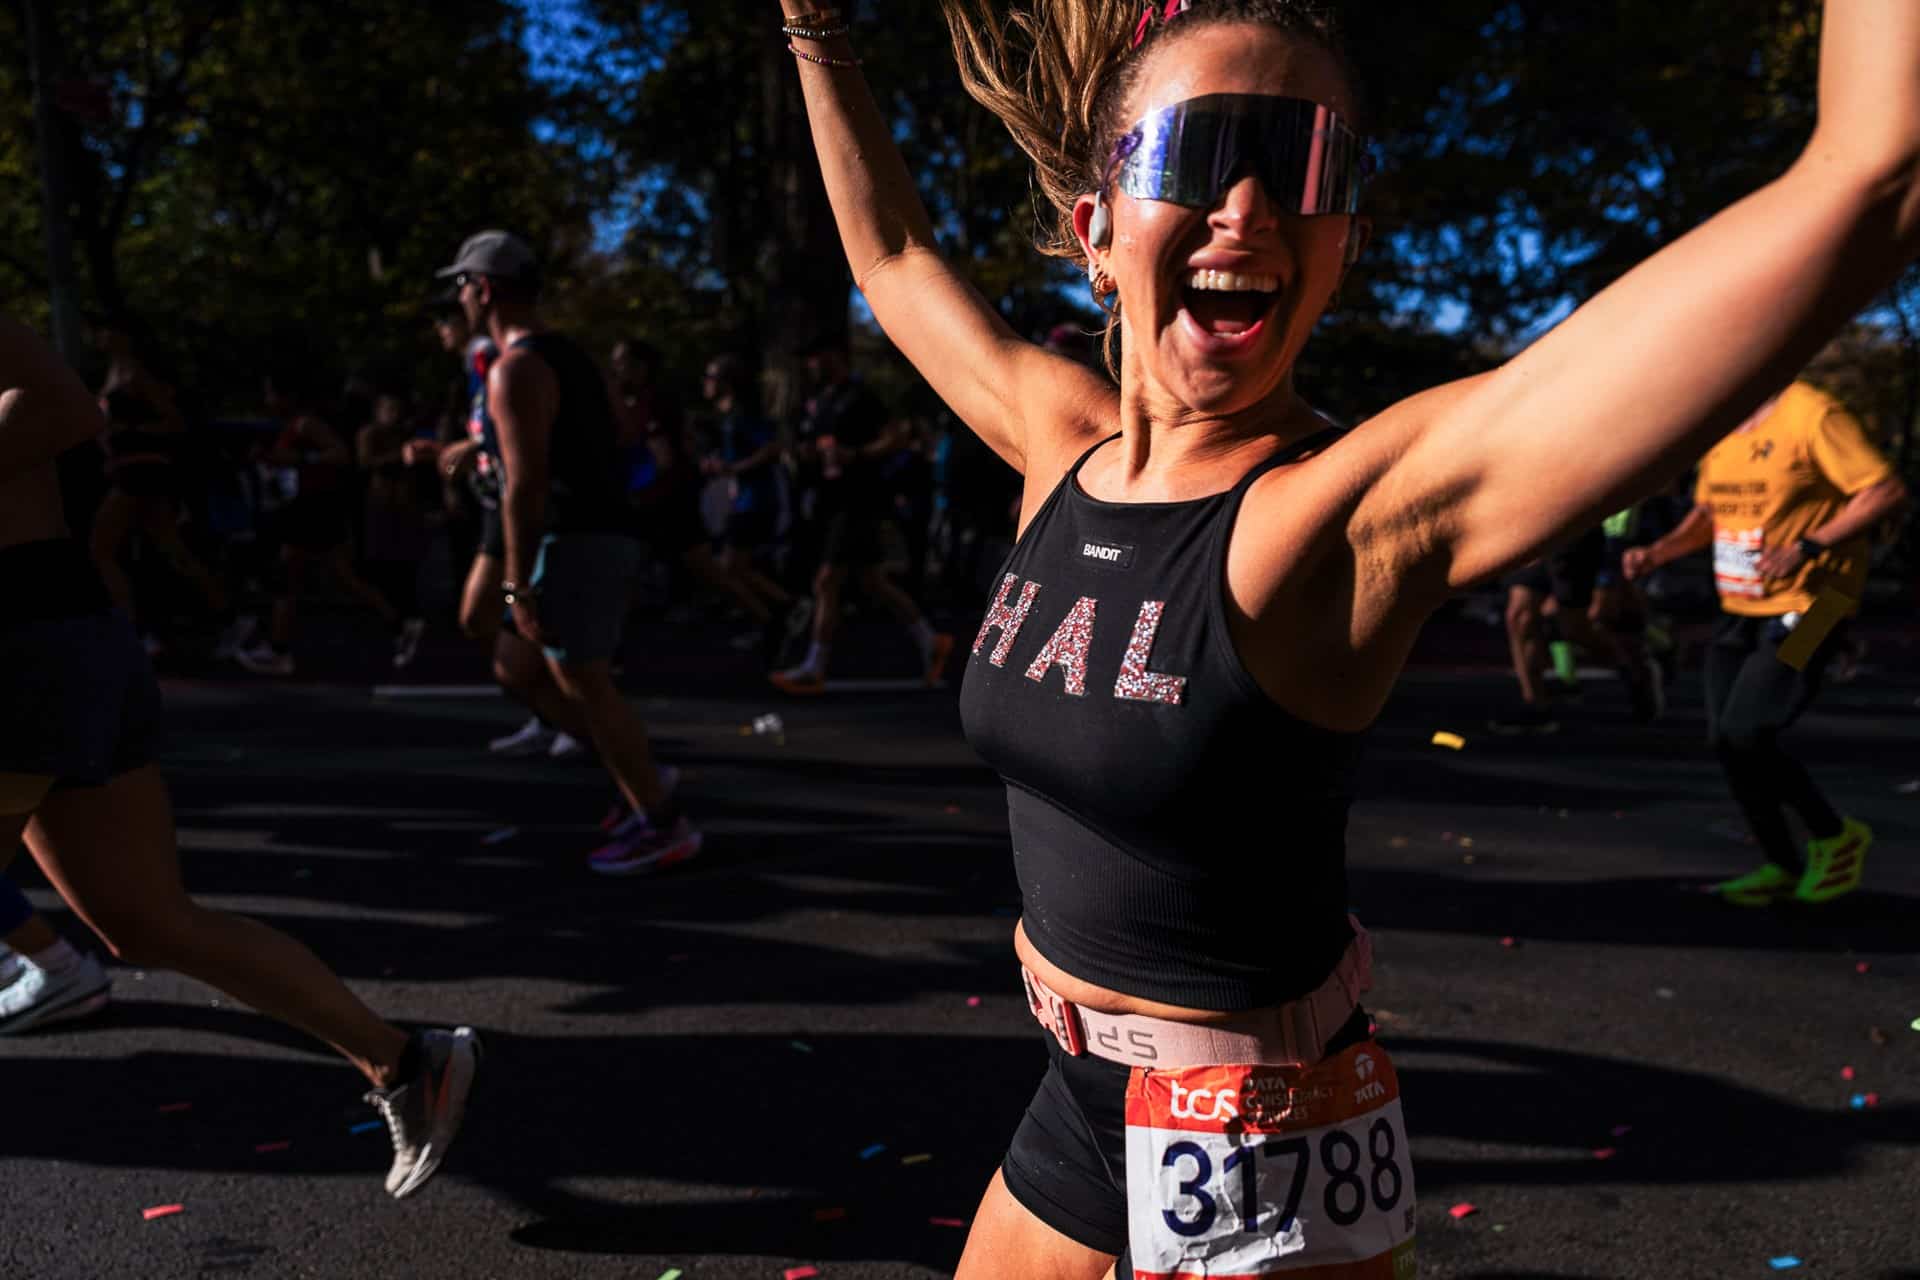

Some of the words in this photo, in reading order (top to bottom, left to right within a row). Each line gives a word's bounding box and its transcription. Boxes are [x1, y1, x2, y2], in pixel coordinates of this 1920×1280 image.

[1083, 543, 1122, 561] BANDIT
[972, 572, 1186, 704] HAL
[1170, 1079, 1239, 1122] tcs
[1353, 1080, 1385, 1104] TATA
[1160, 1117, 1402, 1238] 31788
